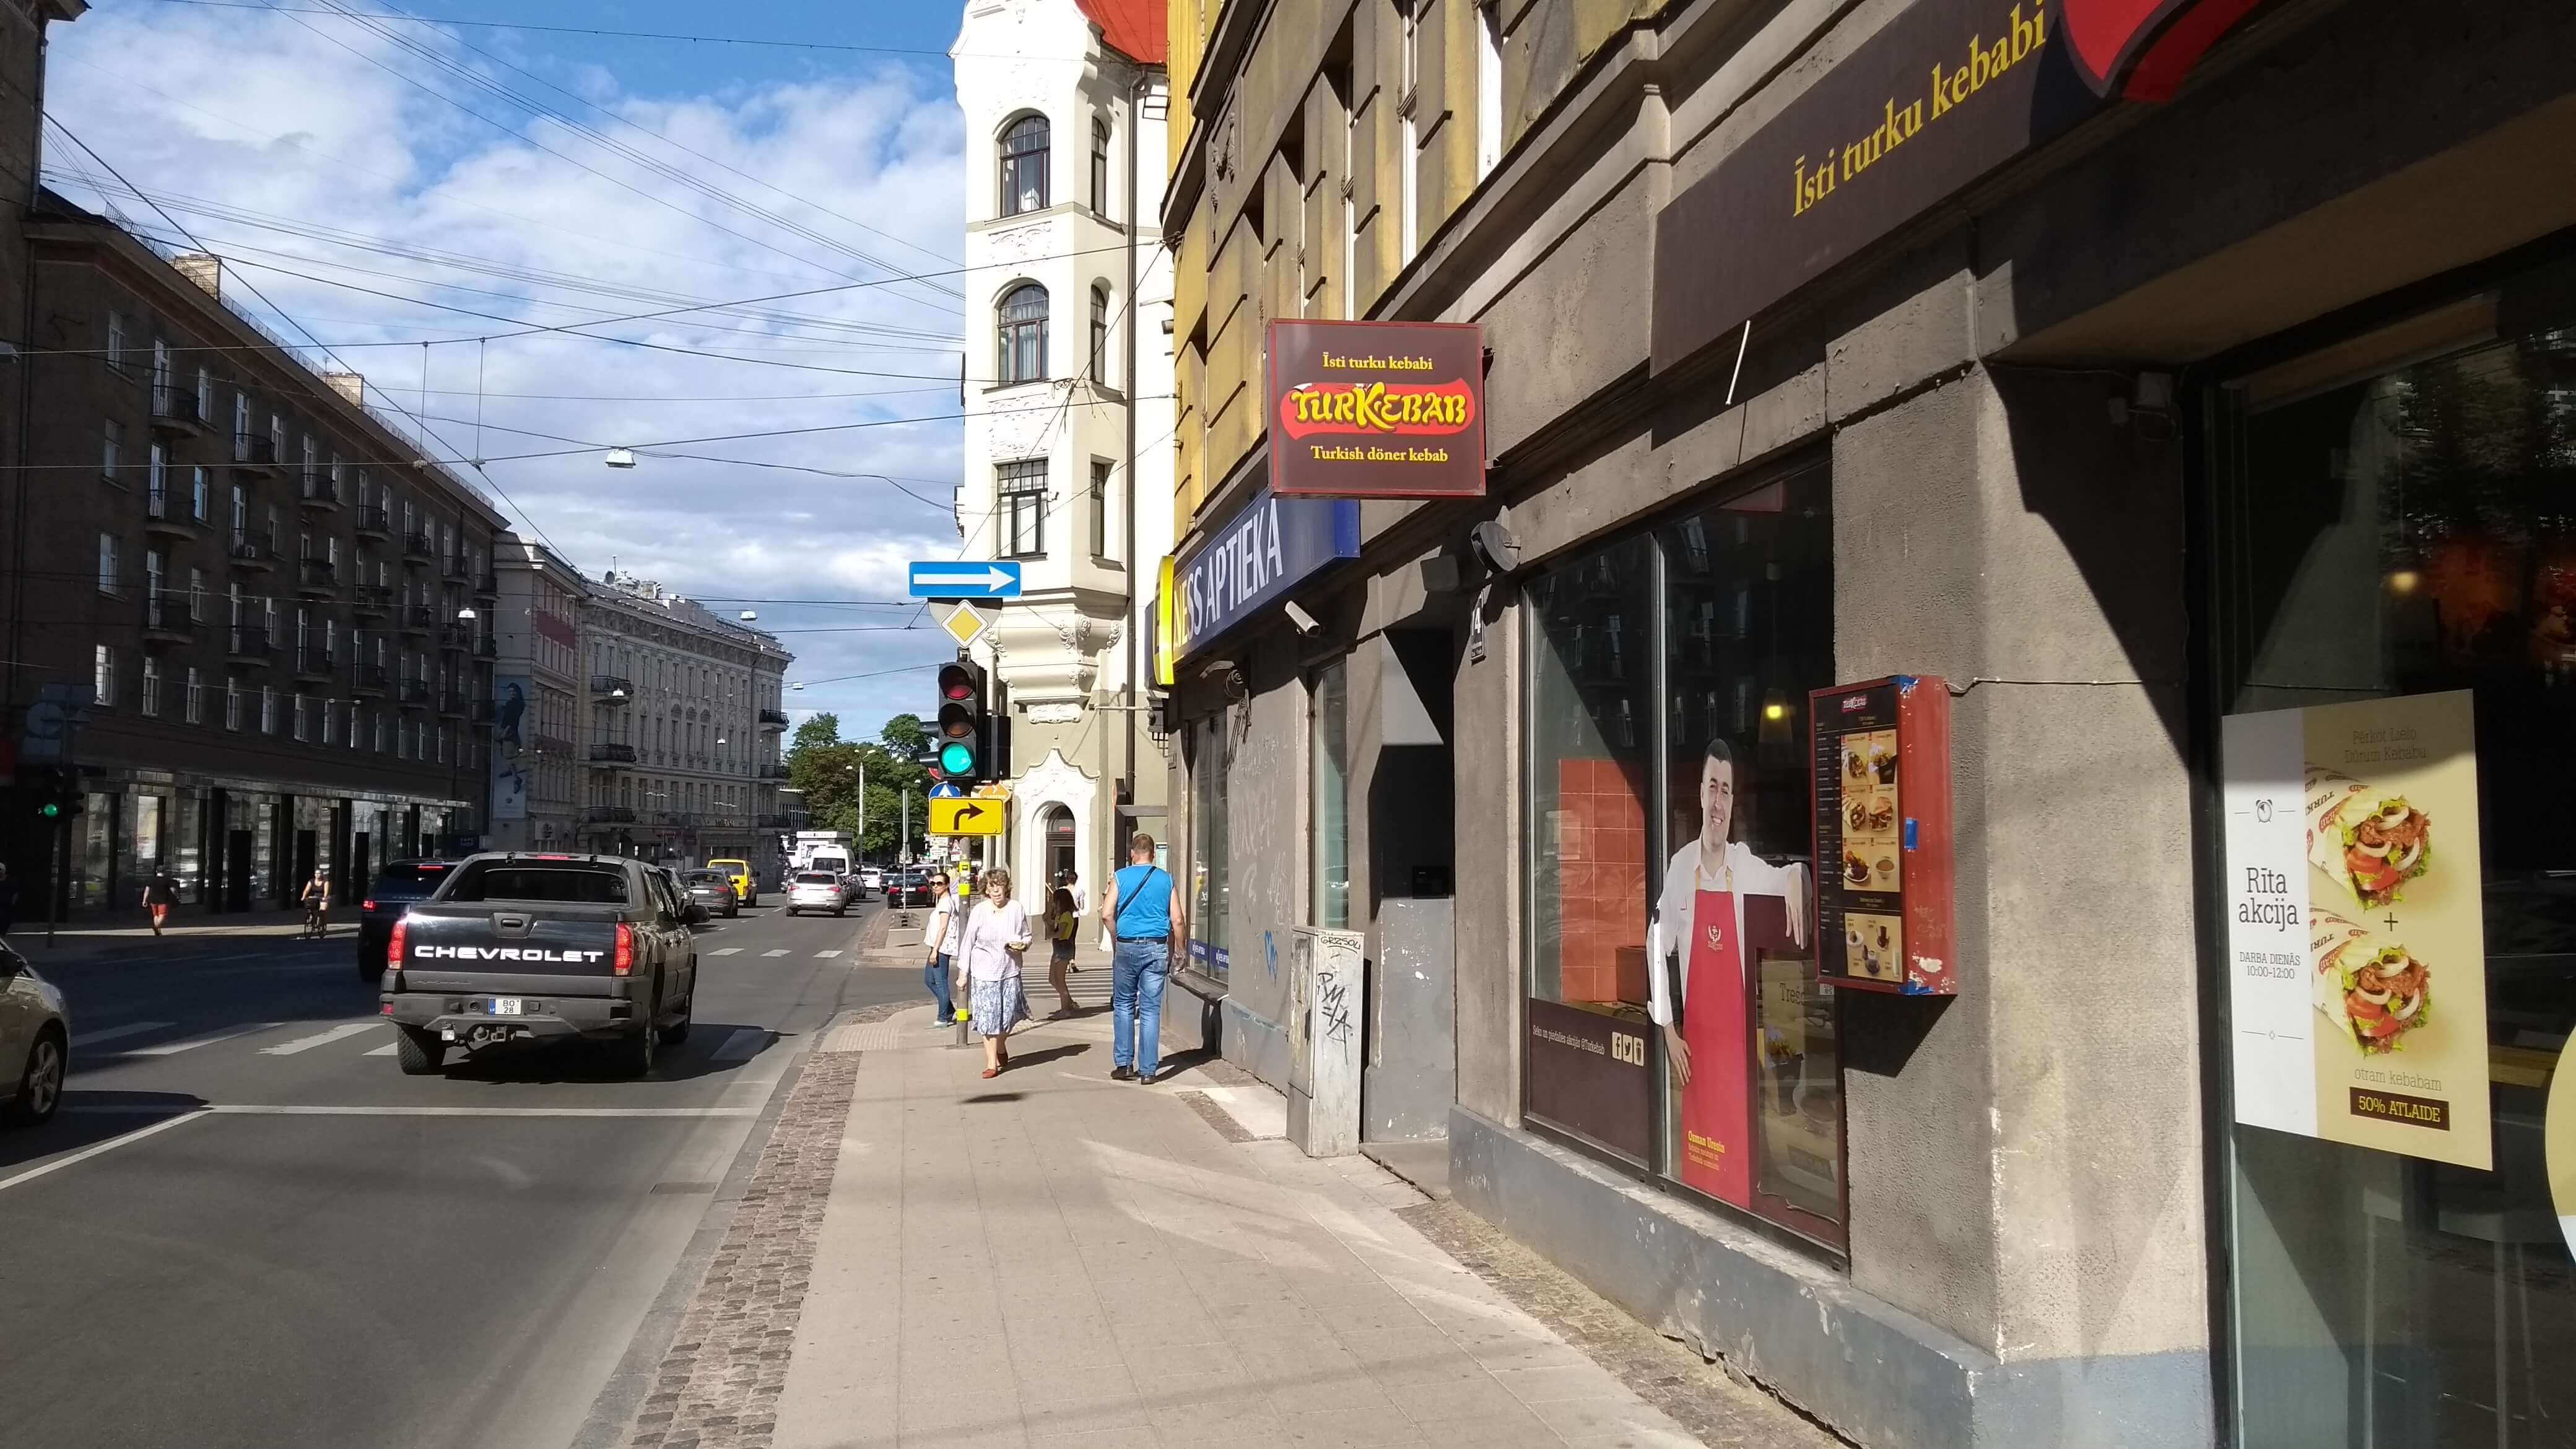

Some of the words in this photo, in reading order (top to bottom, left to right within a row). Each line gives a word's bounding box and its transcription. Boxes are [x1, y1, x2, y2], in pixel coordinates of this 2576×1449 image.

[1793, 148, 1836, 217] Īsti
[1842, 97, 1922, 180] turku
[1931, 0, 2047, 121] kebabi
[1322, 351, 1346, 370] Īsti
[1349, 356, 1386, 370] turku
[1388, 355, 1434, 371] kebabi
[1290, 381, 1466, 432] TURKEBAB
[1310, 445, 1365, 461] Turkish
[1367, 446, 1406, 462] döner
[1408, 447, 1449, 462] kebab
[1205, 497, 1283, 629] APTIEKA
[2384, 744, 2428, 762] Kebabu
[2245, 866, 2289, 895] Rīta
[2239, 896, 2300, 932] akcija
[414, 945, 604, 963] CHEVROLET
[2239, 951, 2267, 965] DARBA
[2268, 950, 2301, 967] DIENĀS
[2246, 965, 2295, 980] 10:00-12:00
[1533, 1025, 1543, 1037] Seko
[1543, 1030, 1548, 1038] un
[1581, 1038, 1605, 1055] @Turkebab
[2354, 1068, 2385, 1084] otram
[2389, 1069, 2442, 1092] kebabam
[2358, 1097, 2386, 1114] 50%
[2388, 1100, 2441, 1123] ATLAIDE
